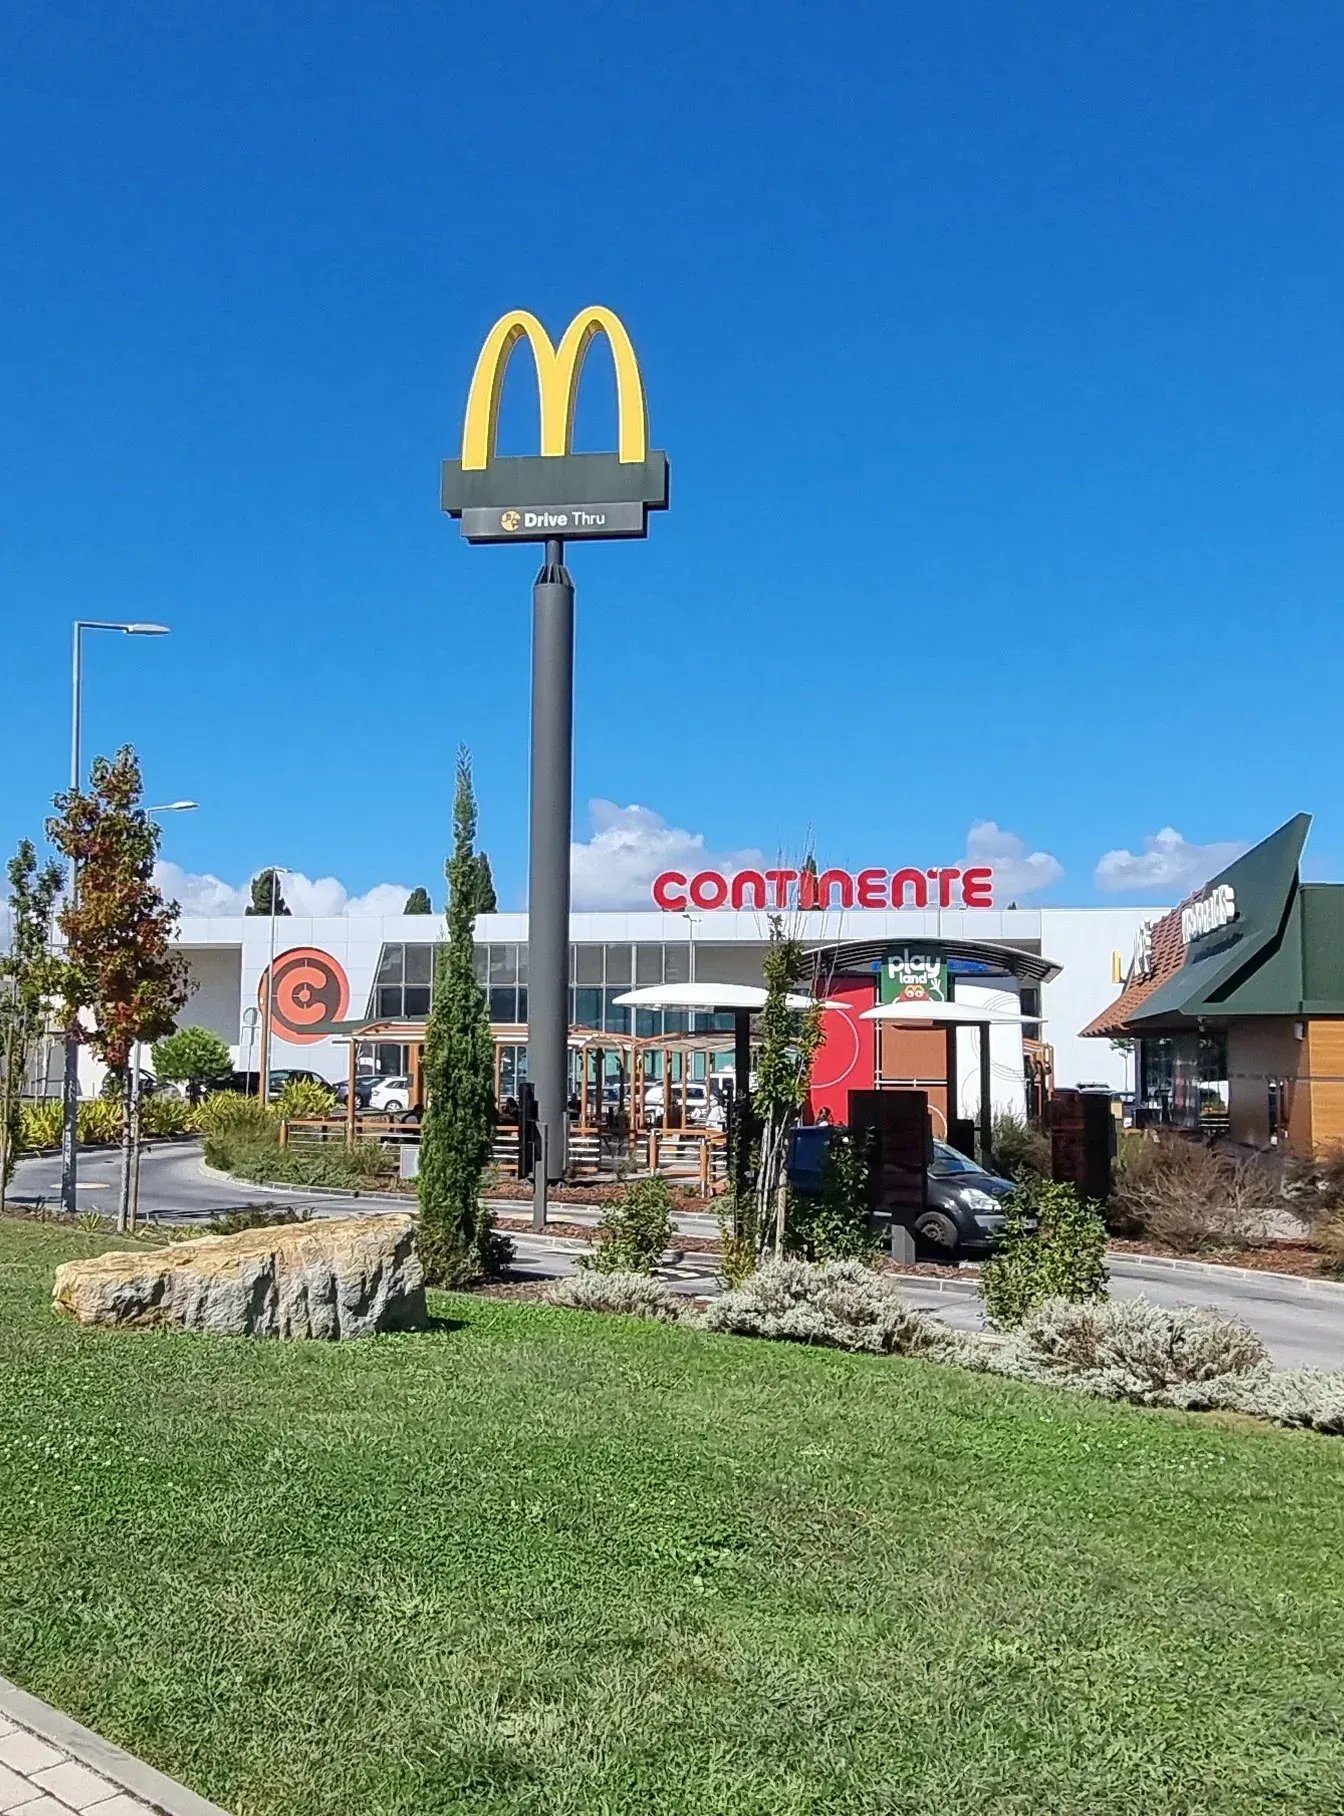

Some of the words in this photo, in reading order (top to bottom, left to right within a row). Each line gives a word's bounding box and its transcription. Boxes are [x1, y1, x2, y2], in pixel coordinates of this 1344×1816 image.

[524, 512, 568, 527] Drive
[572, 511, 606, 525] Thru
[653, 867, 993, 910] CONTINENTE
[888, 948, 941, 979] play
[899, 972, 927, 984] land
